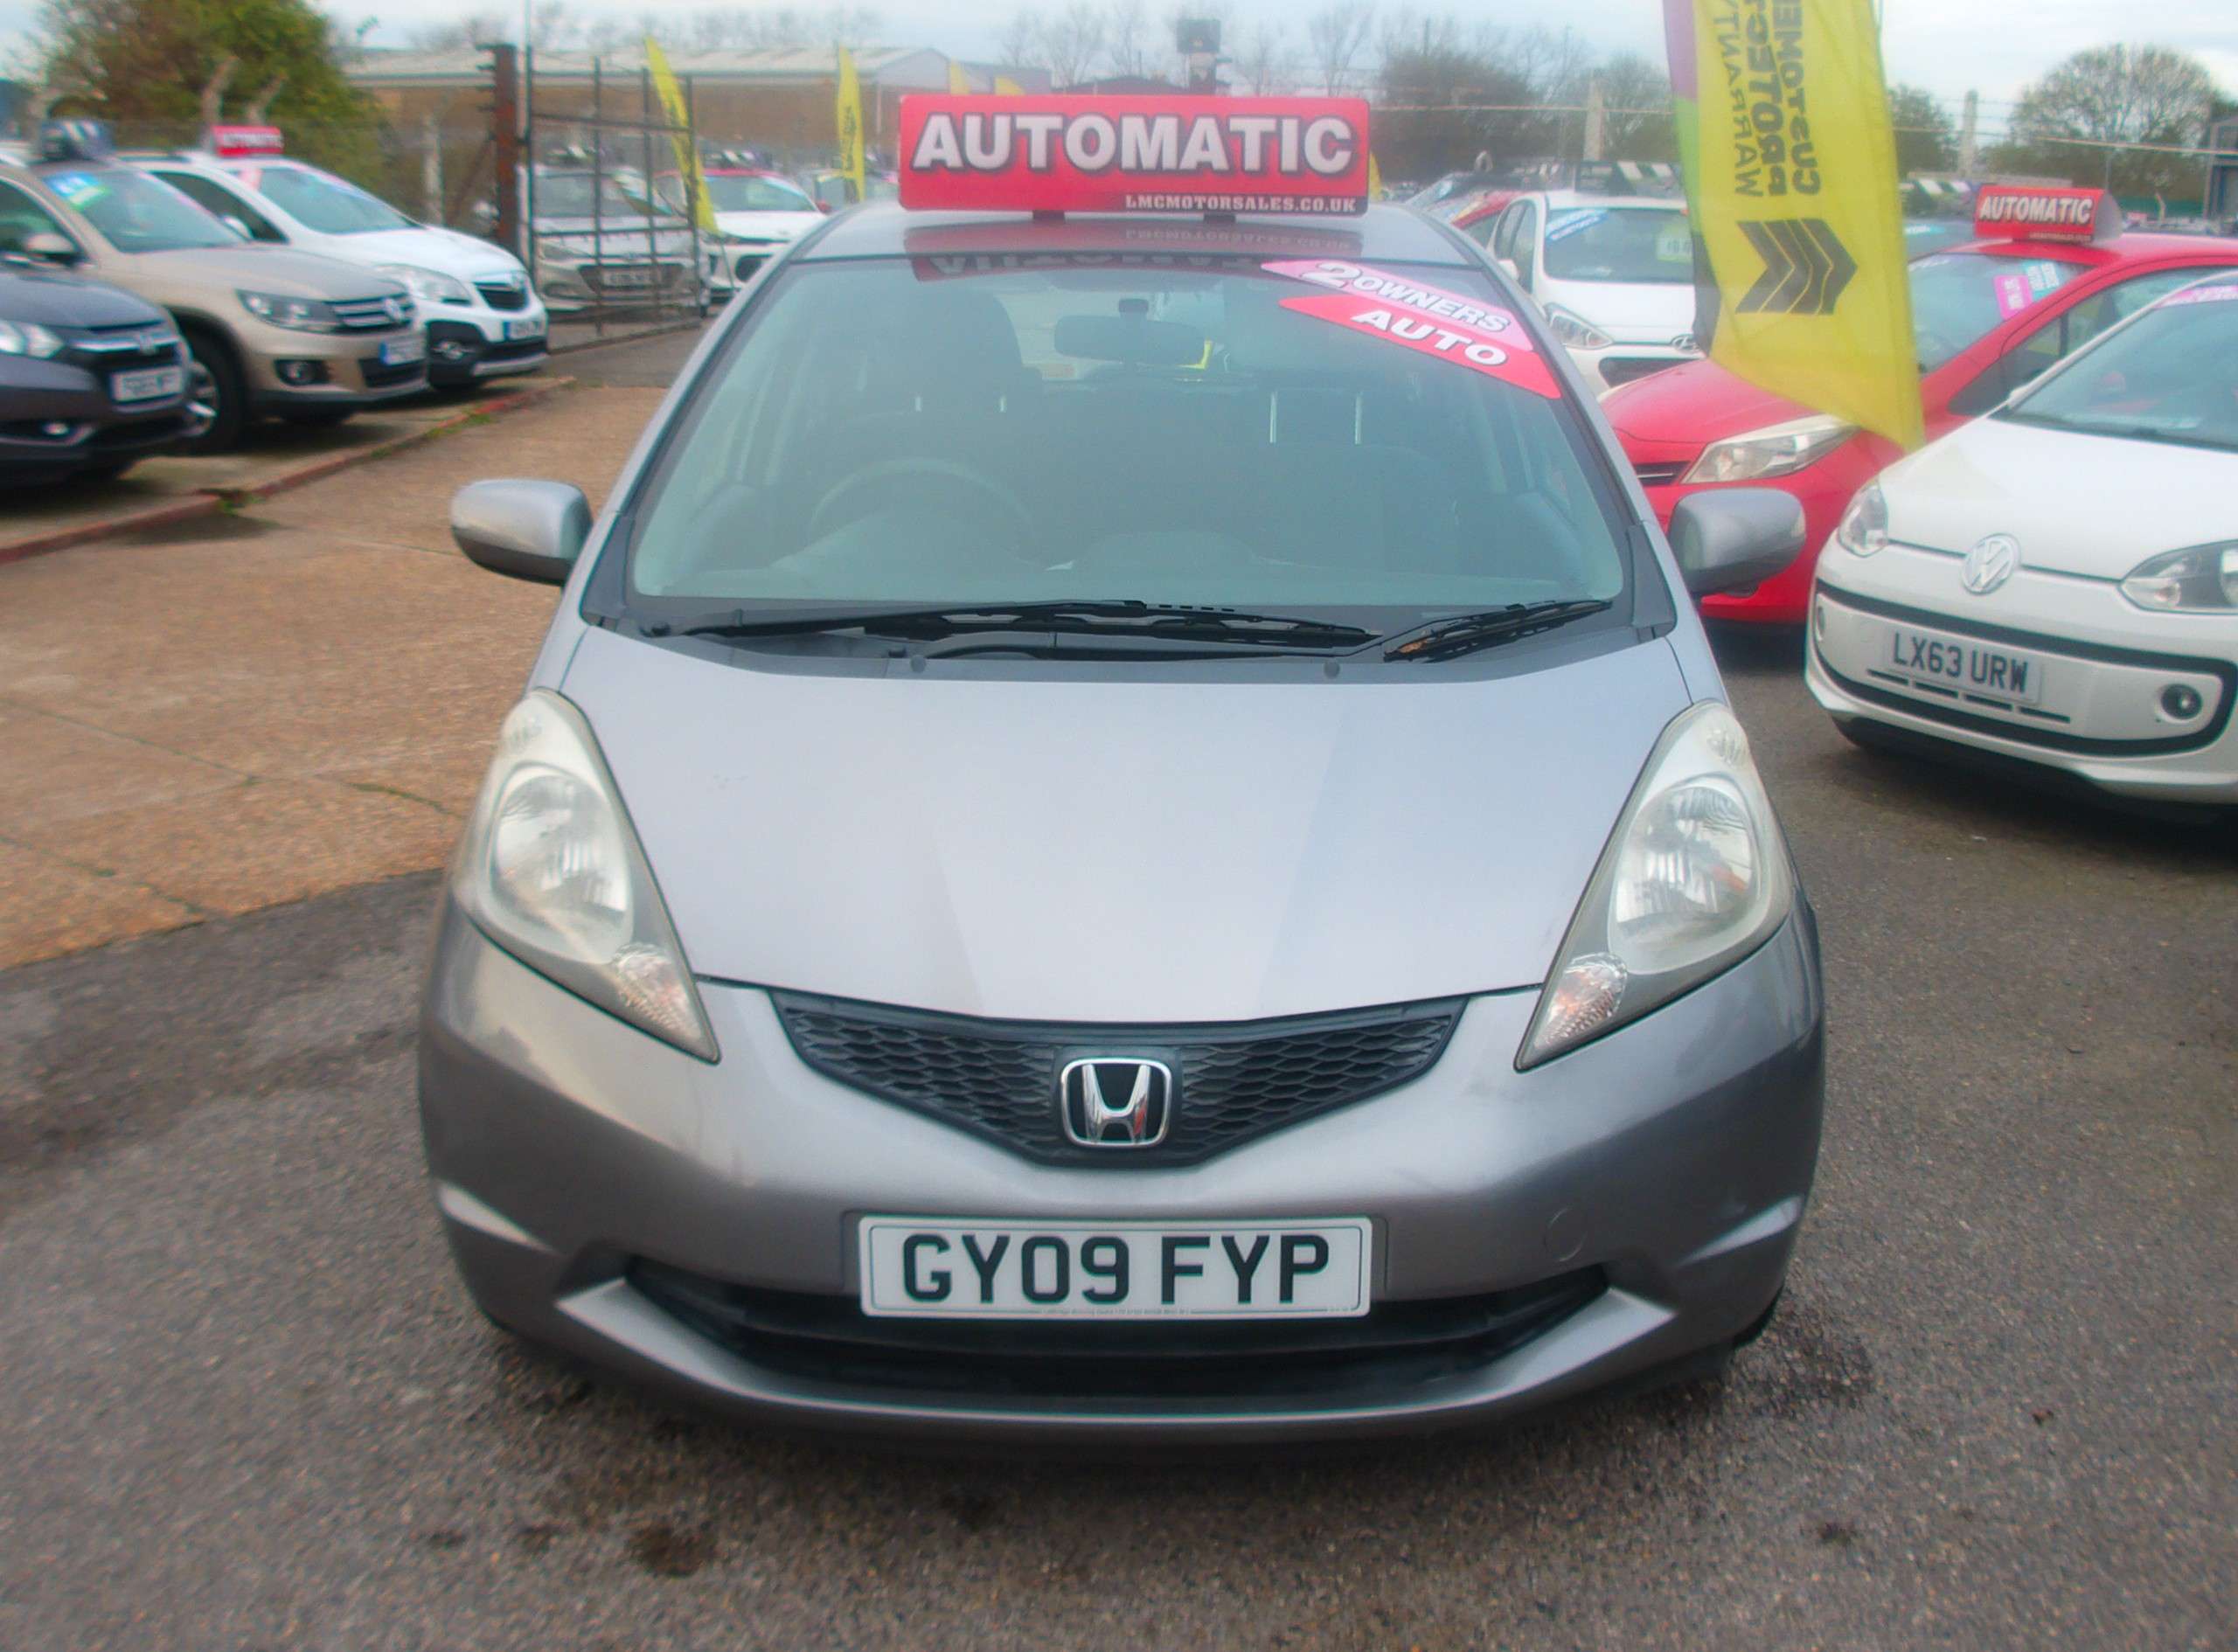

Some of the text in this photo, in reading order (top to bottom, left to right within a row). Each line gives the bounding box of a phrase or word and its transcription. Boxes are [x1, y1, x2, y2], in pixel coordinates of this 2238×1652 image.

[911, 114, 1354, 174] AUTOMATIC
[1125, 194, 1357, 213] LMCMOTORSALES.CO.UK
[1979, 196, 2094, 225] AUTOMATIC
[1351, 309, 1507, 365] AUTO
[1894, 632, 2028, 693] LX63 URW
[902, 1233, 1329, 1305] GY09 FYP
